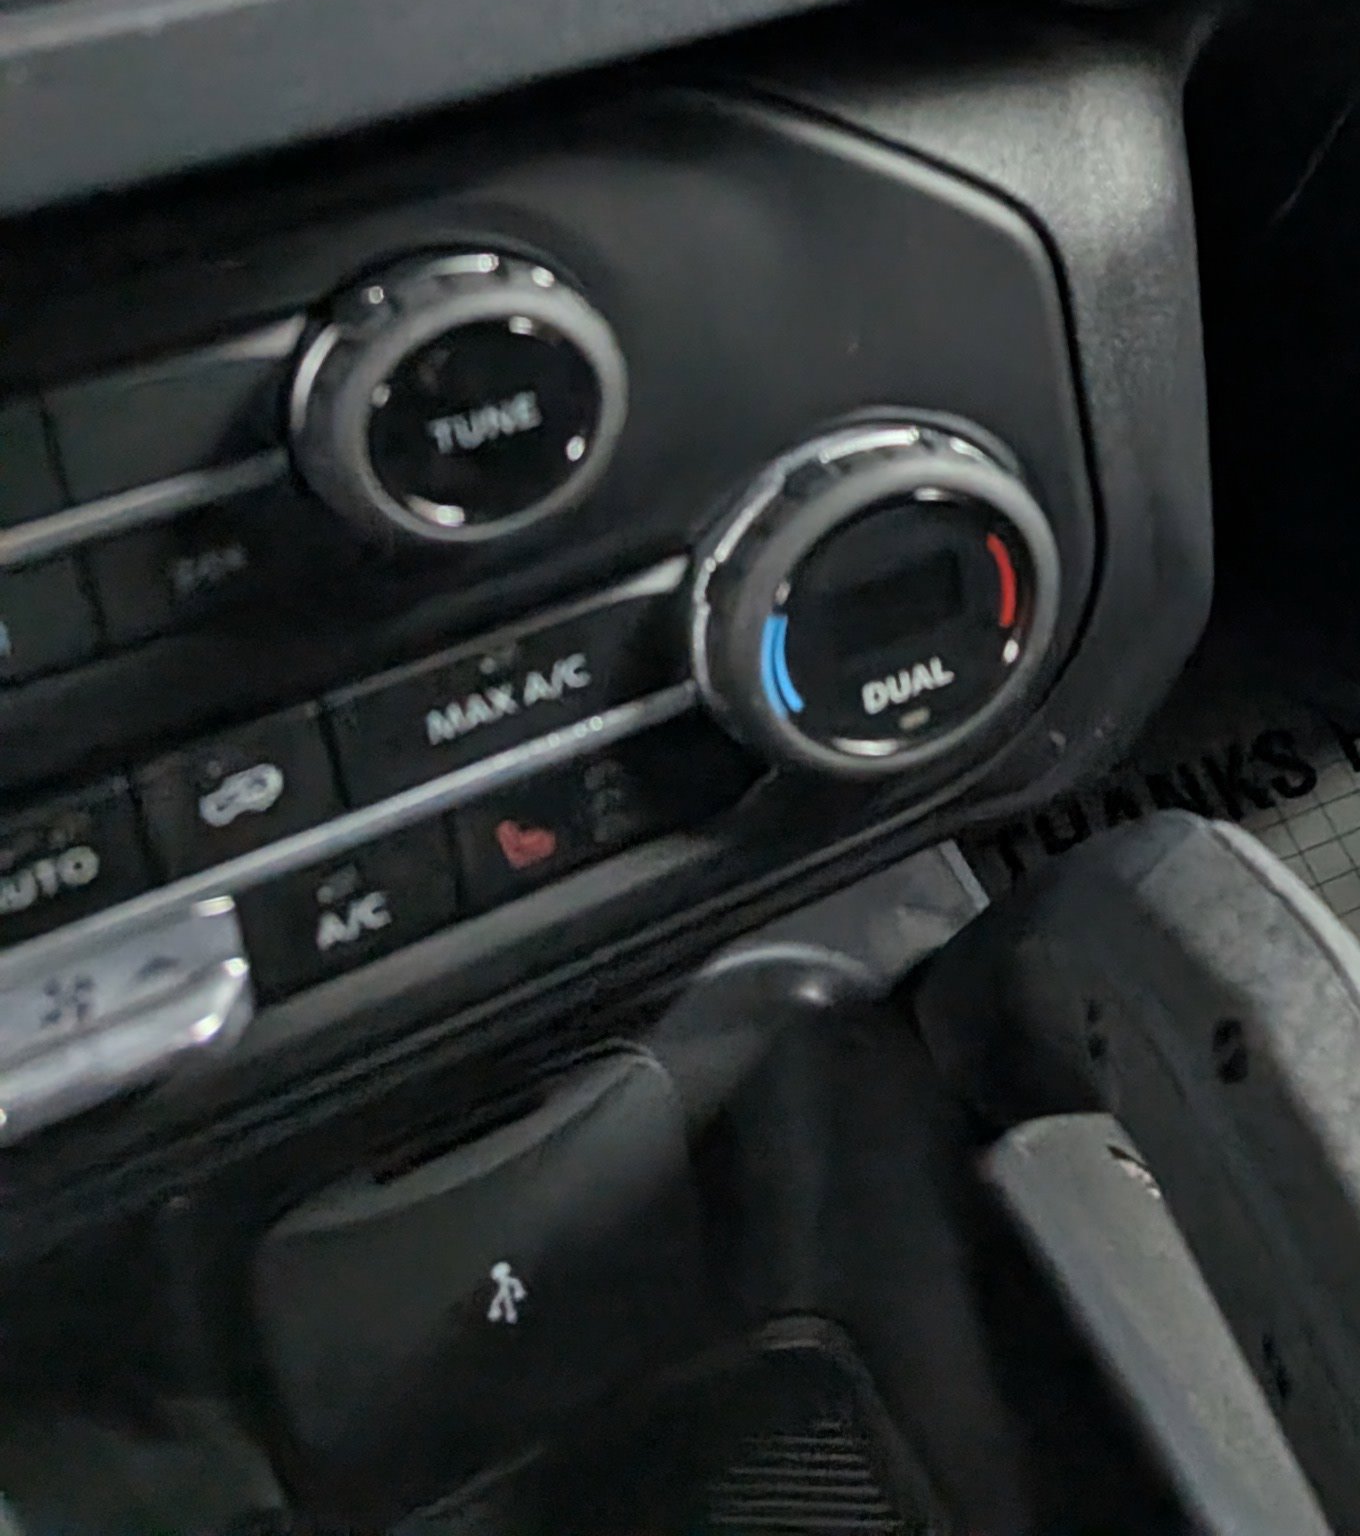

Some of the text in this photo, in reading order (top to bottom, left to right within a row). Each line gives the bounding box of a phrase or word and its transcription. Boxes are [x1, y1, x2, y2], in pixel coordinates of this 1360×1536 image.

[424, 389, 543, 455] TUNE
[424, 651, 594, 747] MAX A/C
[860, 653, 957, 716] DUAL
[0, 844, 100, 916] UTO
[315, 889, 394, 952] A/C
